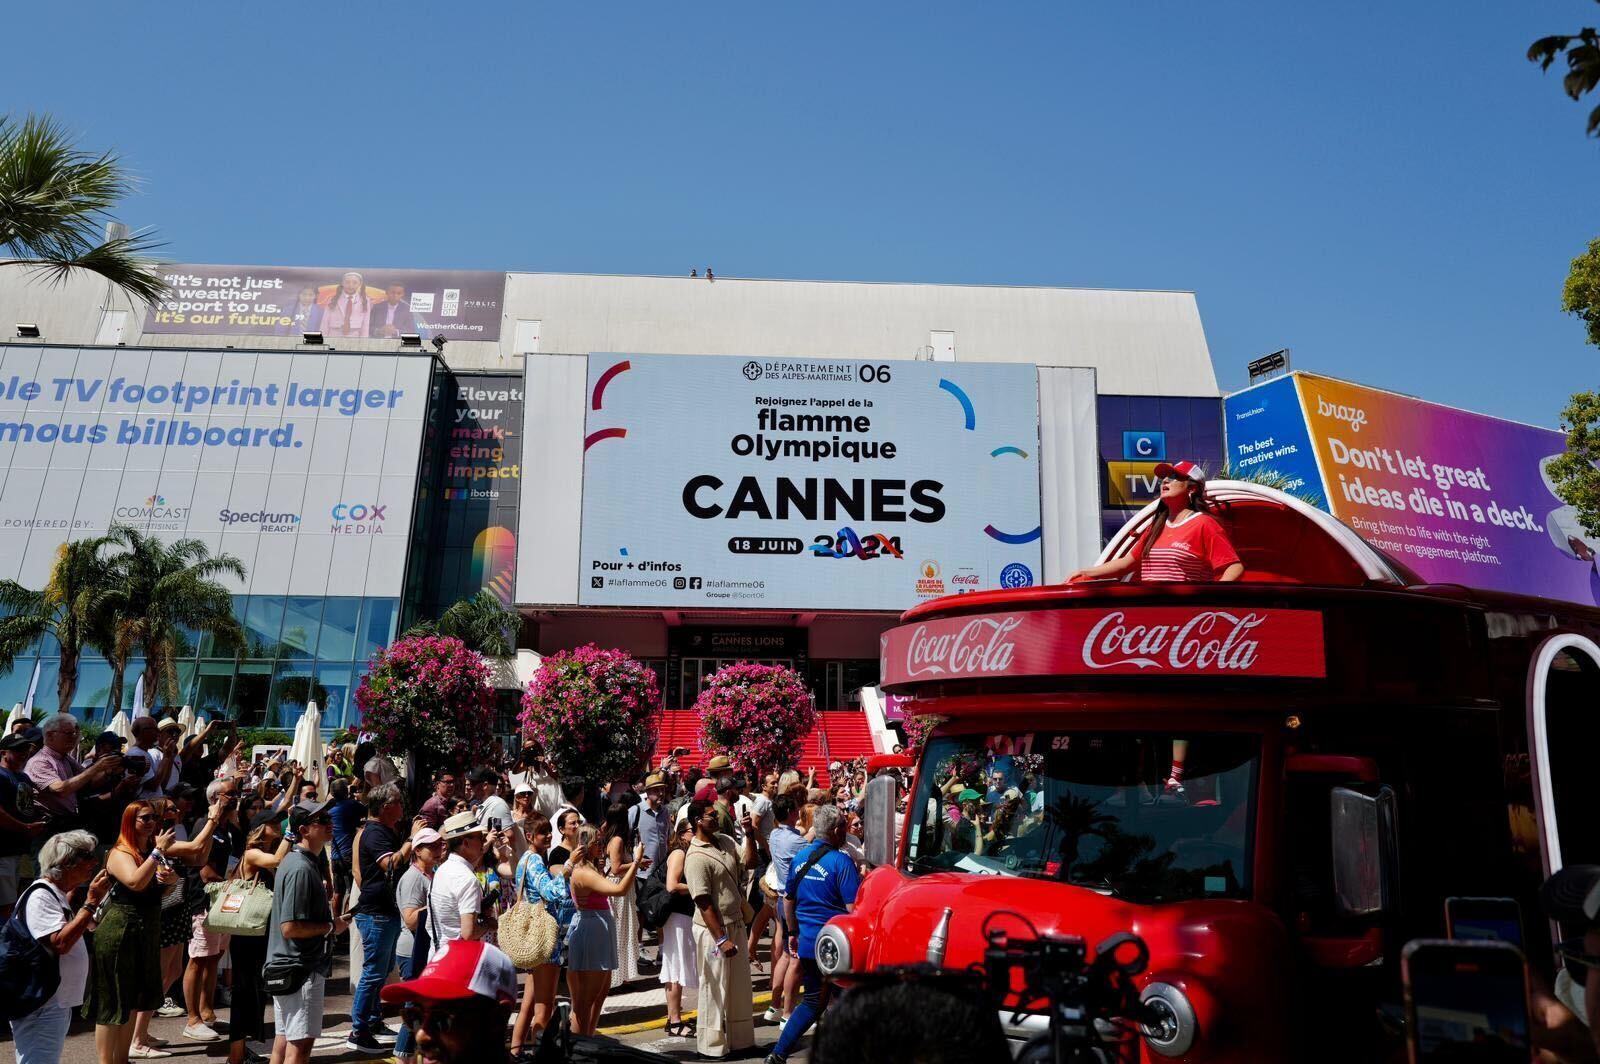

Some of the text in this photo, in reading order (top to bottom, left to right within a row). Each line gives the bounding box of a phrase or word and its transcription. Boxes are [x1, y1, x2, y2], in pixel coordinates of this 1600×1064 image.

[164, 274, 283, 290] “It’s not just
[178, 289, 262, 301] weather
[158, 301, 281, 313] report to us.
[155, 312, 185, 324] It’s
[190, 314, 224, 325] our
[416, 322, 484, 332] WeatherKids.org
[765, 362, 891, 383] DÉPARTEMENT 06
[765, 372, 852, 382] DES ALPES-MARITIMES
[52, 378, 103, 402] TV
[109, 377, 279, 412] footprint
[286, 383, 403, 416] larger
[755, 396, 874, 408] Rejoignez l’appel de la
[455, 408, 503, 423] your
[757, 408, 871, 433] flamme
[1236, 407, 1265, 421] TransUnion
[1317, 394, 1368, 432] braze
[116, 418, 304, 448] billboard.
[451, 425, 513, 440] mark-
[449, 444, 504, 462] eting
[731, 434, 897, 463] Olympique
[1136, 437, 1152, 455] C
[1238, 437, 1274, 455] The best
[1239, 445, 1298, 468] creative wins.
[1328, 438, 1491, 492] Don't let great
[447, 462, 519, 480] impact
[1125, 474, 1159, 493] TV
[470, 488, 500, 499] ibotta
[682, 474, 946, 524] CANNES
[116, 506, 191, 519] COMCAST
[331, 503, 387, 521] COX
[1339, 474, 1544, 533] ideas die in a deck.
[4, 519, 95, 529] POWERED BY:
[218, 508, 295, 525] Spectrum
[260, 525, 294, 533] REACH
[330, 524, 384, 535] MEDIA
[1352, 516, 1491, 549] Bring them to life with the right
[734, 530, 904, 560] 18 JUIN 2024
[1366, 538, 1501, 565] stomer engagement platform.
[592, 560, 682, 572] Pour + d’infos
[608, 579, 765, 589] #laflamme06 #laflamme06
[706, 592, 731, 600] Groupe
[711, 636, 785, 646] CANNES LIONS
[906, 616, 1024, 678] Coca-Cola
[1082, 611, 1268, 670] Coca-Cola
